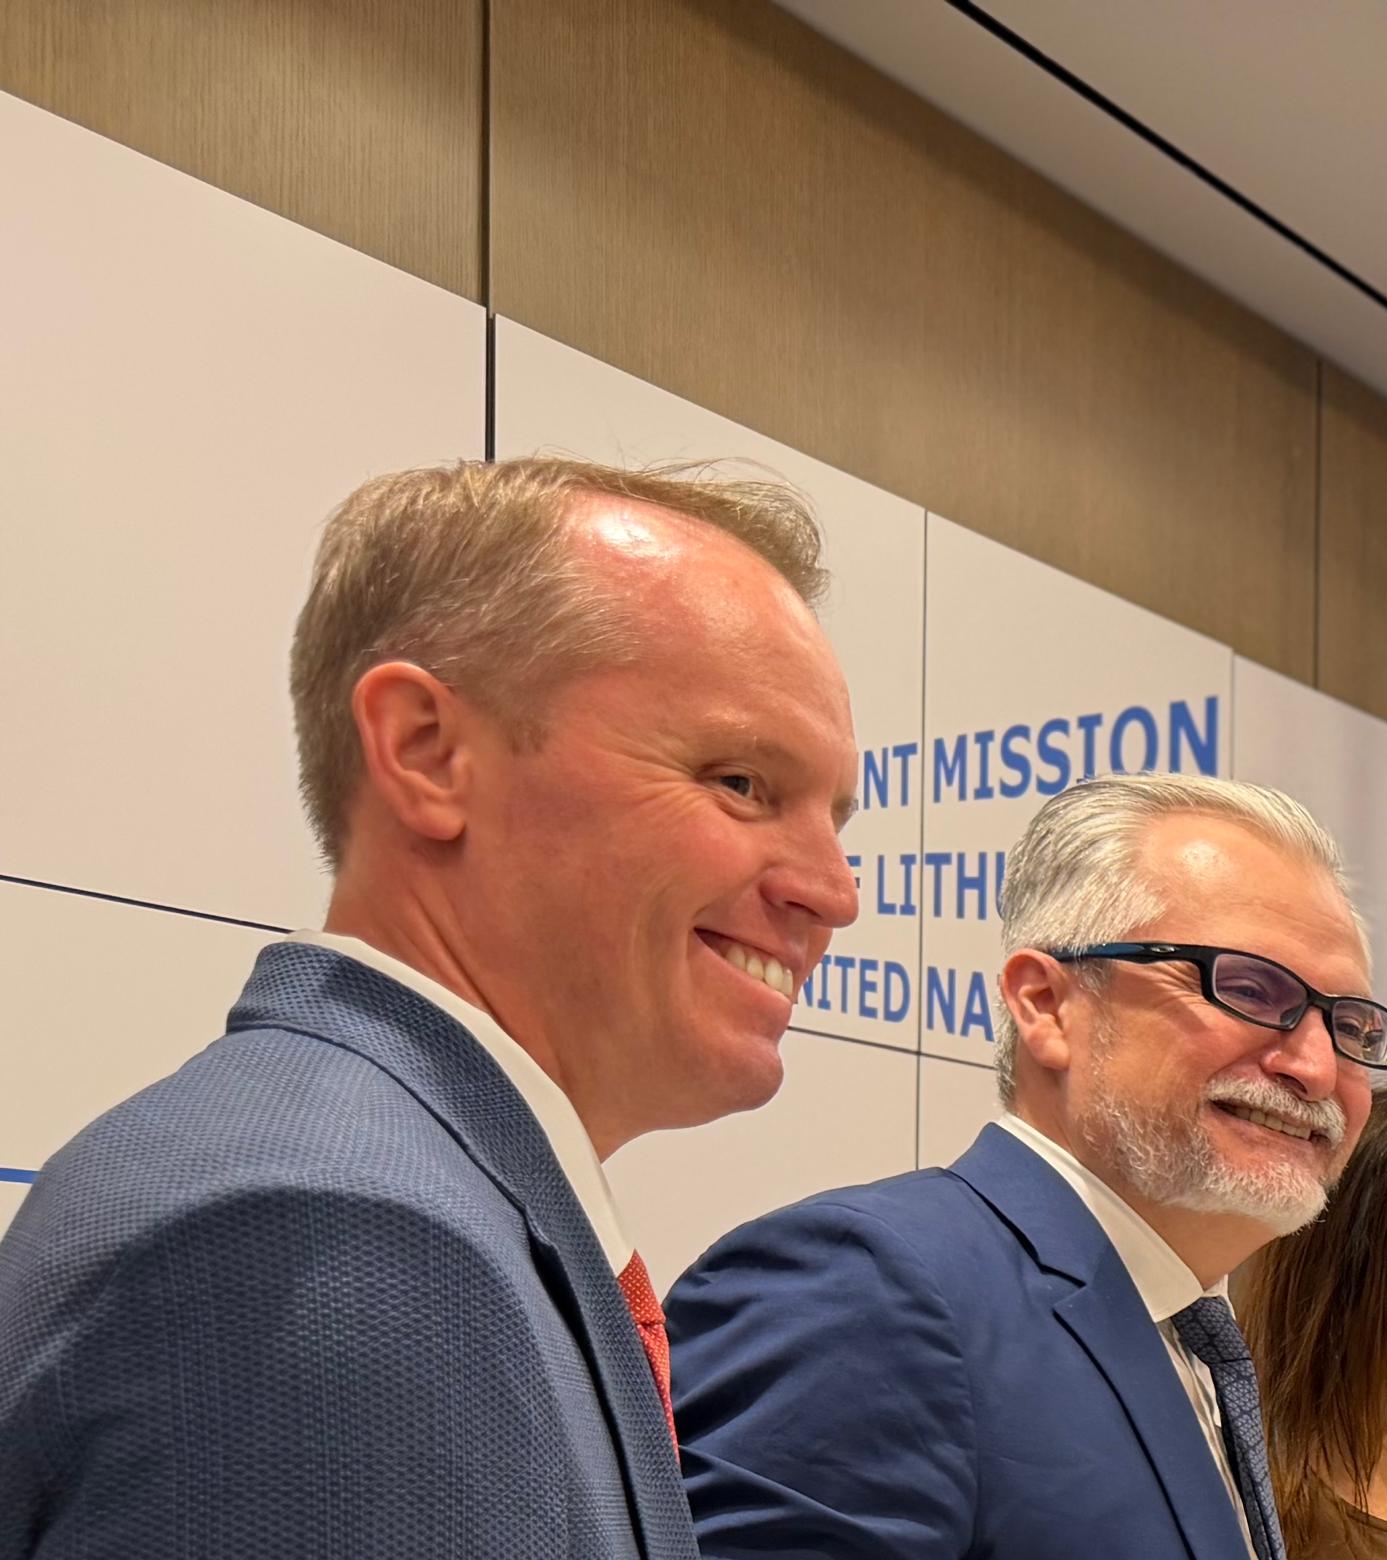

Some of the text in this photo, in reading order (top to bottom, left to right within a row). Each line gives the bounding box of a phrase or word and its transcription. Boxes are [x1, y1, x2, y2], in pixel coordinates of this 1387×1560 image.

[852, 695, 1219, 811] NT MISSION
[927, 965, 1001, 1042] NA
